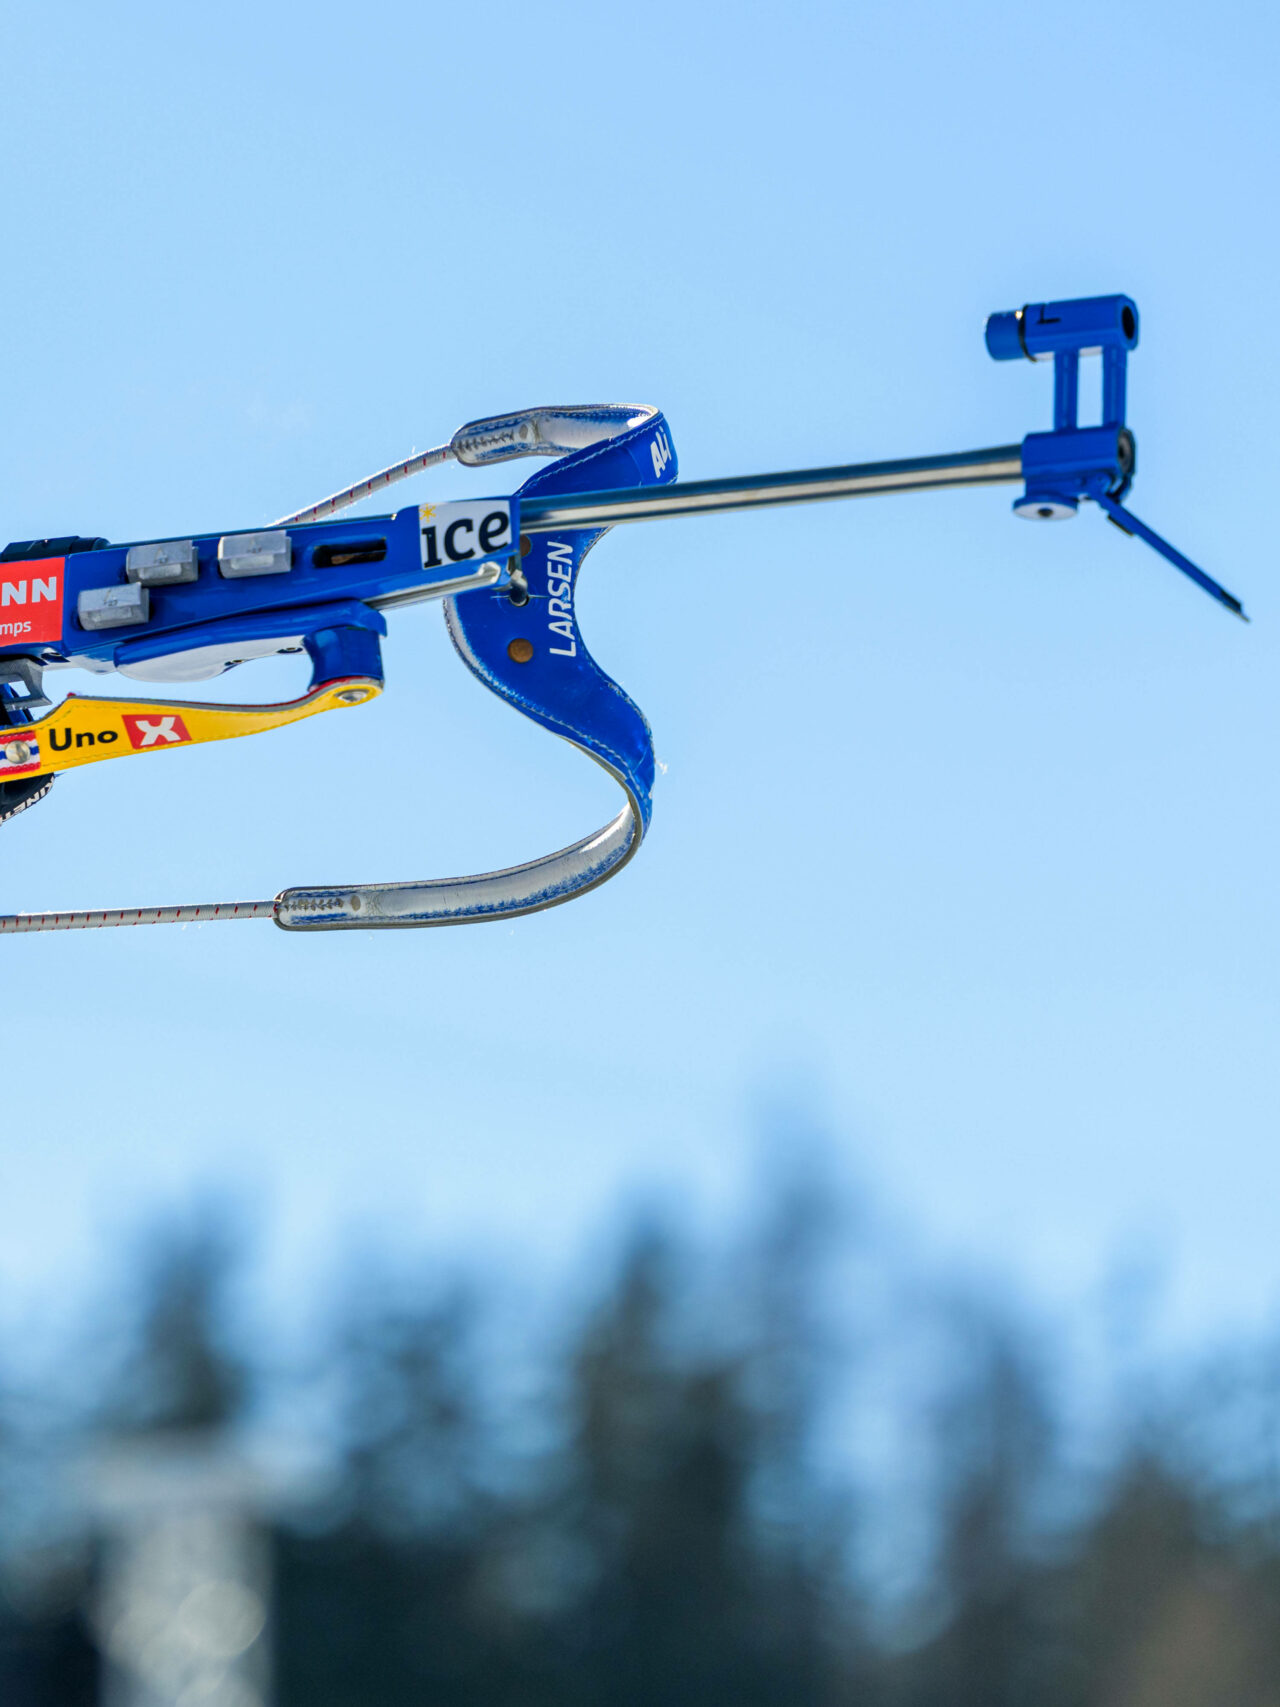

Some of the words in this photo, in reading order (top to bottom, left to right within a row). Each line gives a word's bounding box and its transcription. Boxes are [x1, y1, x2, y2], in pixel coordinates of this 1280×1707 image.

[421, 510, 509, 568] ice
[547, 541, 577, 657] LARSEN
[49, 728, 118, 751] Uno
[135, 716, 181, 746] X
